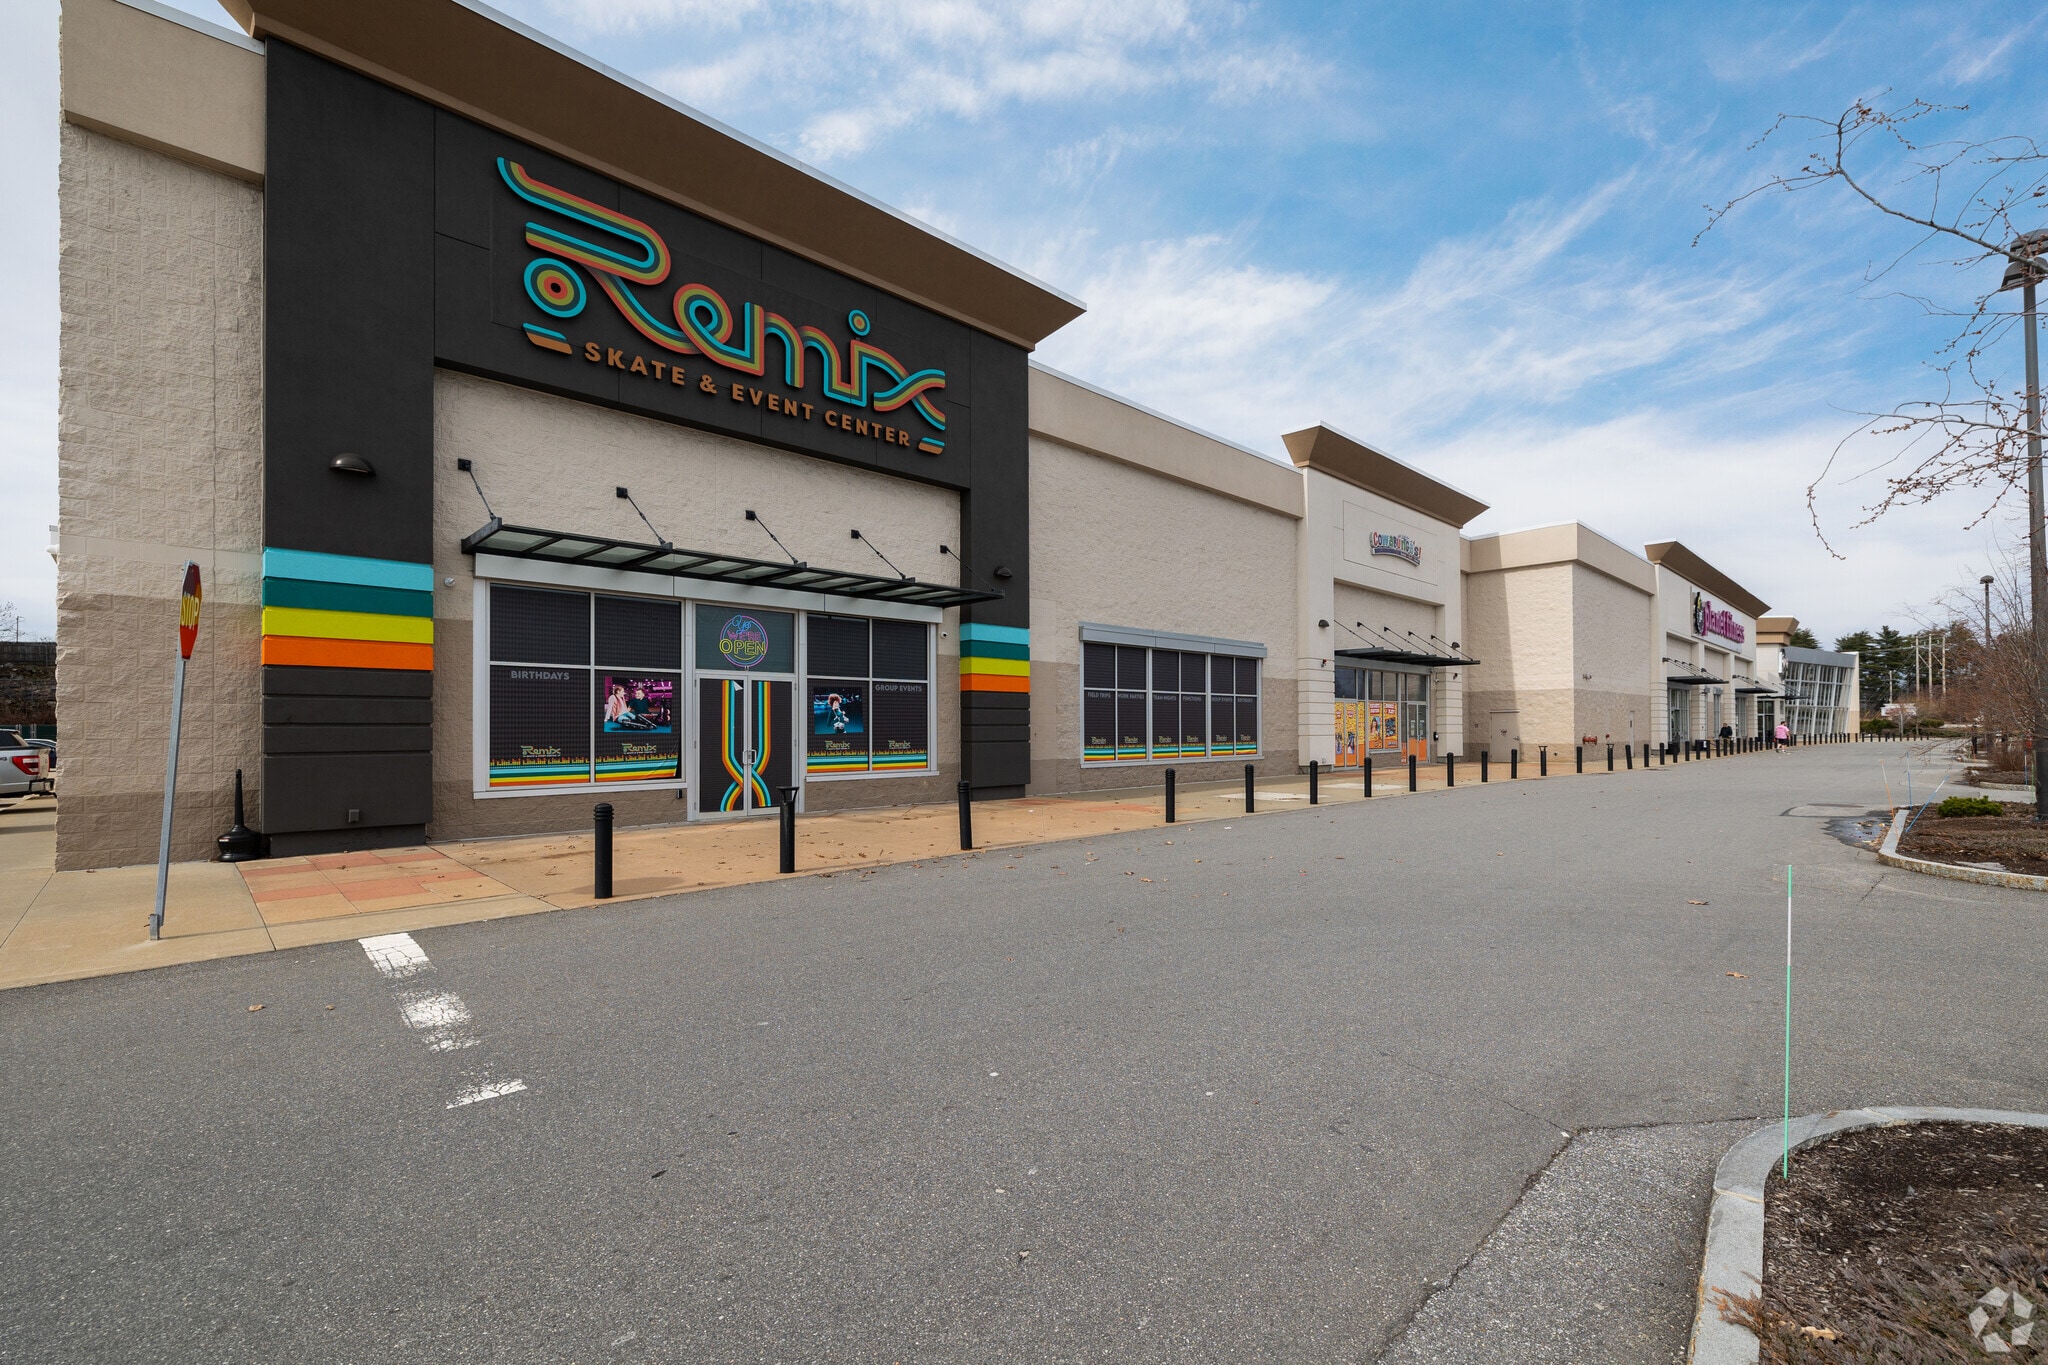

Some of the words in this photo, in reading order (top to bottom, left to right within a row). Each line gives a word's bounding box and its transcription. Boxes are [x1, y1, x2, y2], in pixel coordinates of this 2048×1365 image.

[496, 156, 946, 431] Remix
[584, 341, 686, 386] SKATE
[699, 374, 719, 395] &
[731, 382, 815, 420] EVENT
[824, 409, 911, 447] CENTER
[181, 591, 200, 631] STOP
[719, 638, 766, 656] OPEN
[511, 670, 570, 680] BIRTHDAYS
[875, 684, 898, 692] GROUP
[520, 745, 561, 756] Remix
[621, 743, 657, 754] Remix
